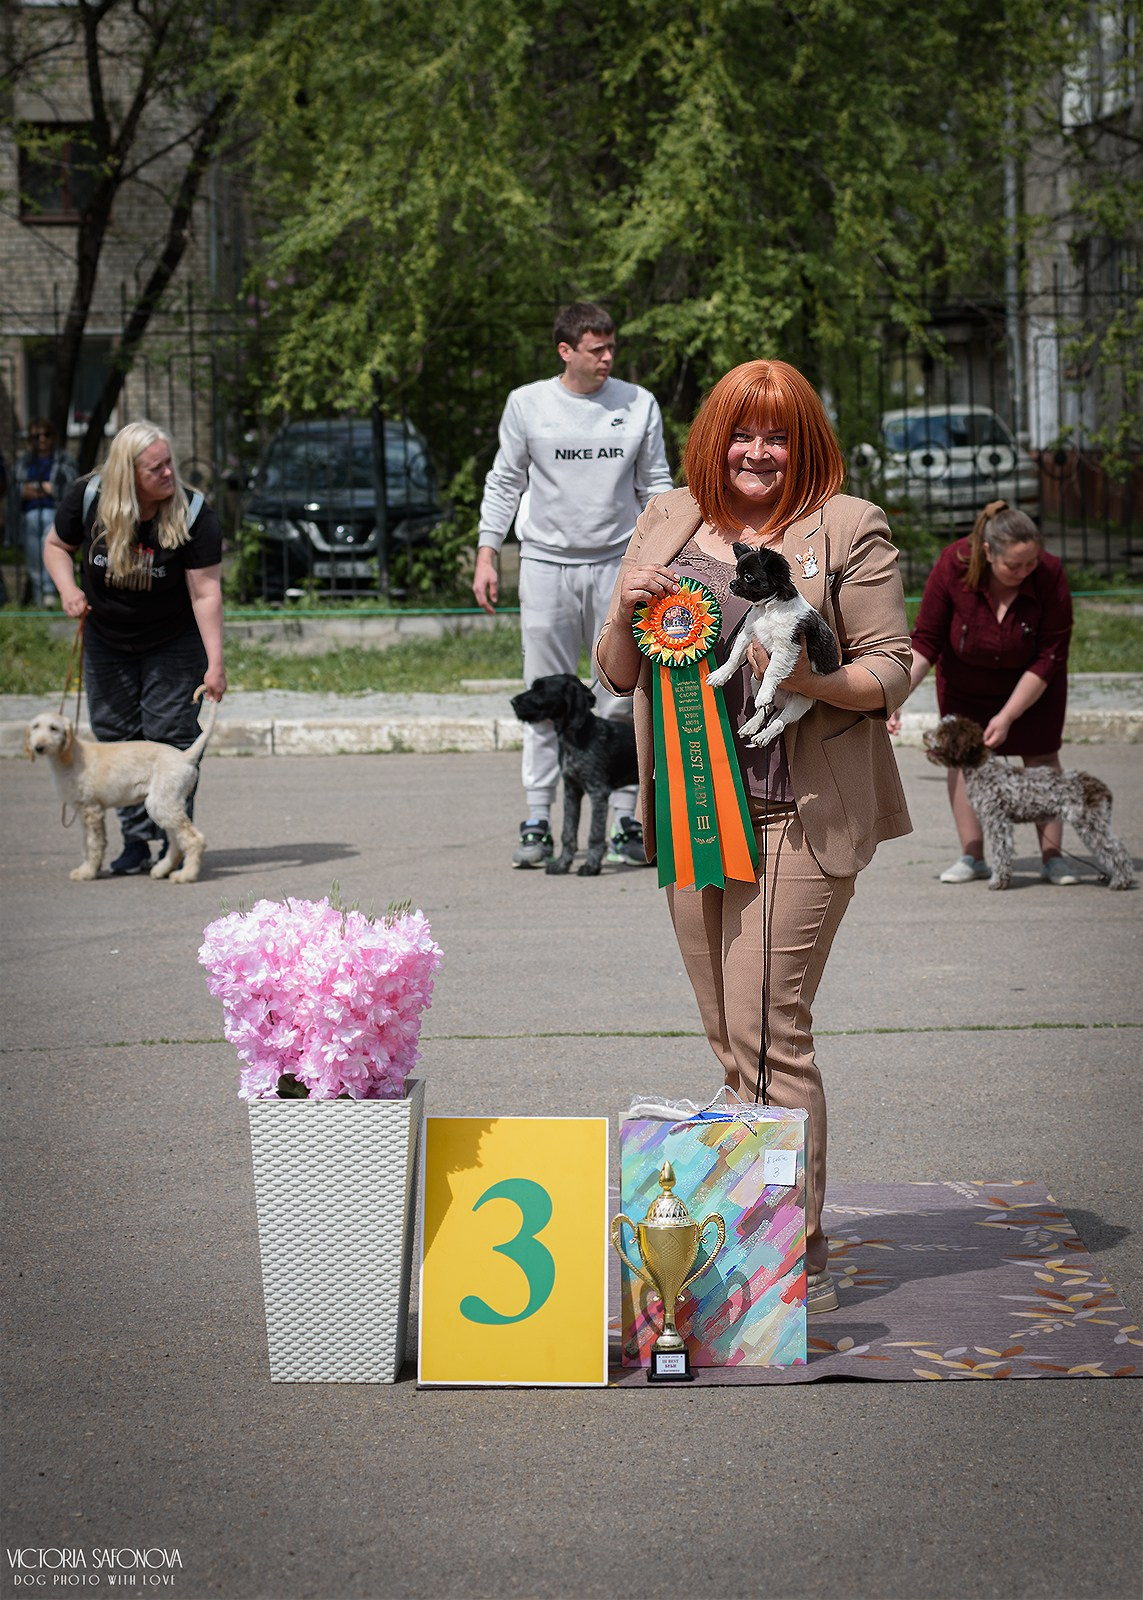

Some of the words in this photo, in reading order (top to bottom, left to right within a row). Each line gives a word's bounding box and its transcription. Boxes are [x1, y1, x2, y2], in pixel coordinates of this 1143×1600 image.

[555, 448, 593, 460] NIKE
[597, 447, 625, 458] AIR
[688, 740, 704, 770] BEST
[692, 775, 708, 808] BABY
[773, 1167, 781, 1178] 3
[459, 1178, 556, 1325] 3
